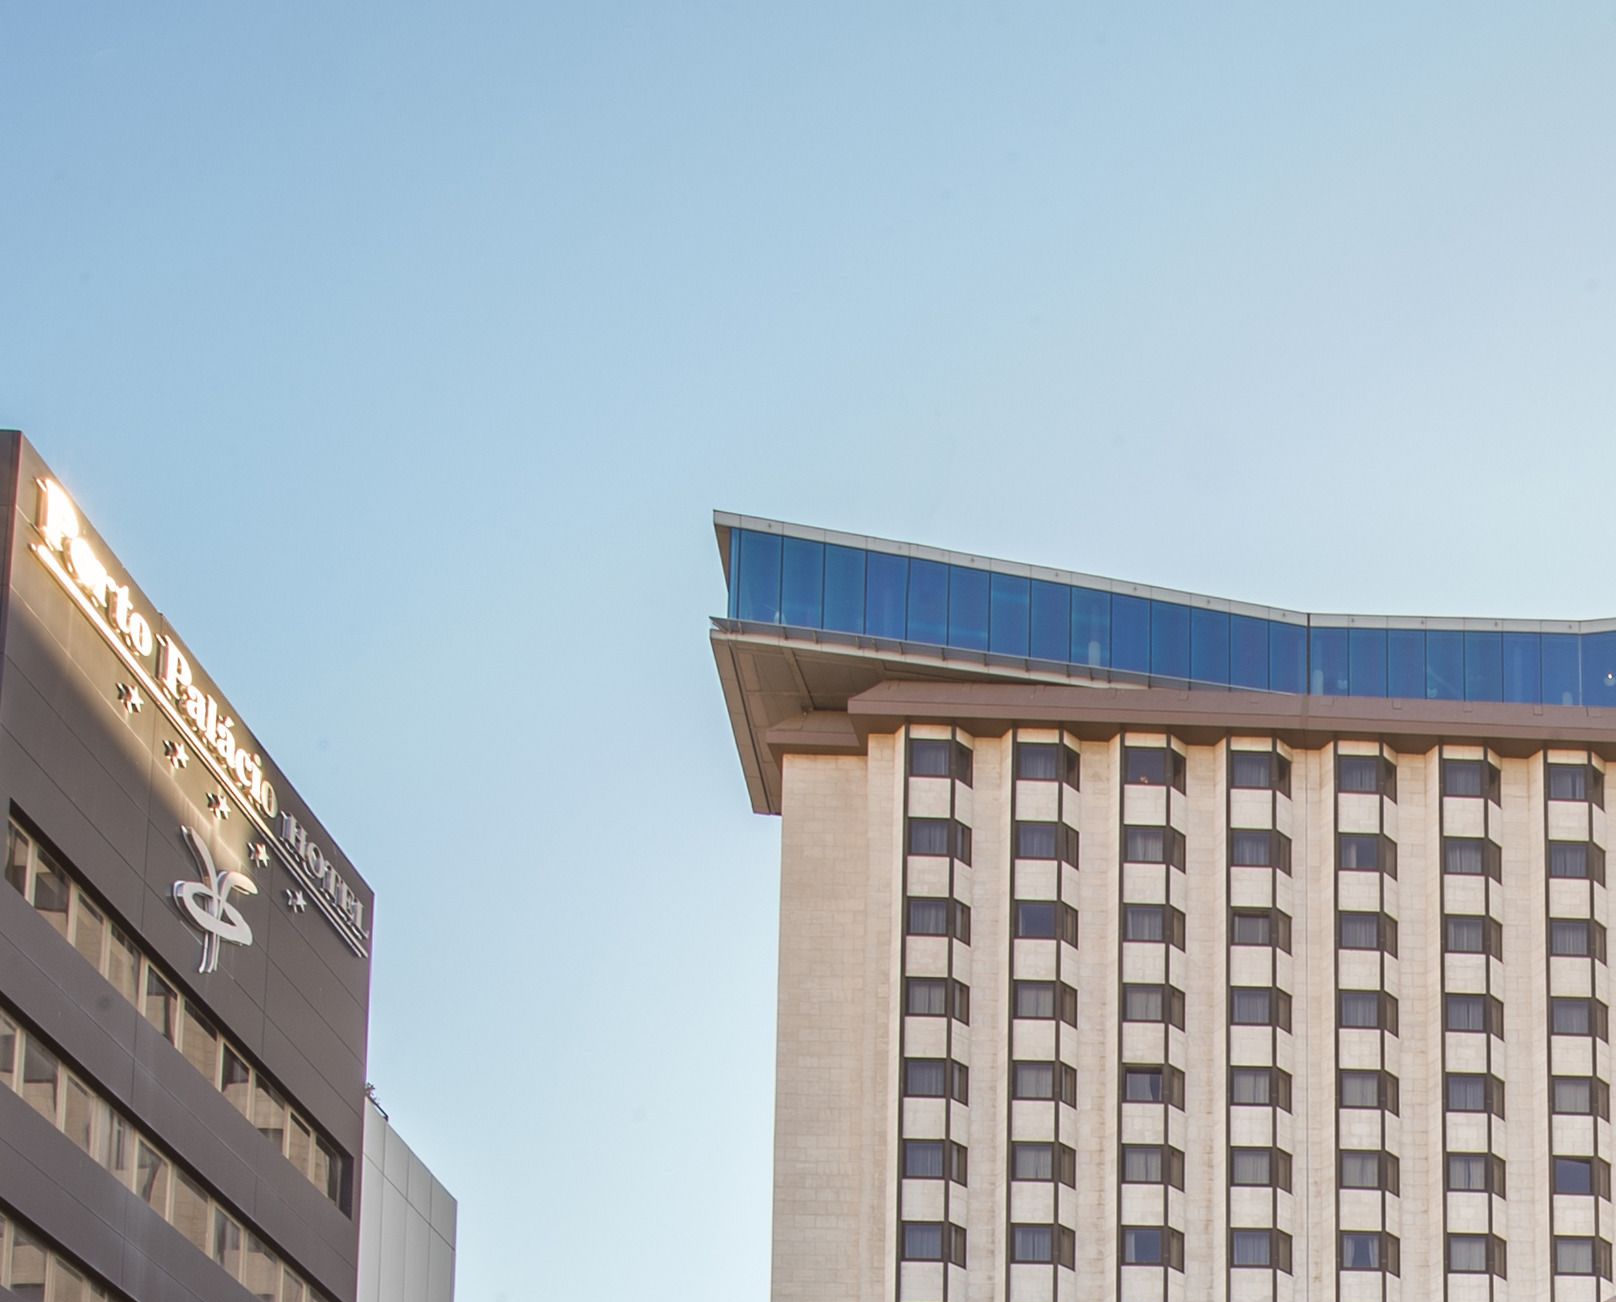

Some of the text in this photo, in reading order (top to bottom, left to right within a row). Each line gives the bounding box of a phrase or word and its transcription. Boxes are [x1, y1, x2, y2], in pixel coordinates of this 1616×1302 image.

[37, 477, 369, 940] Porto Palácio HOTEL
